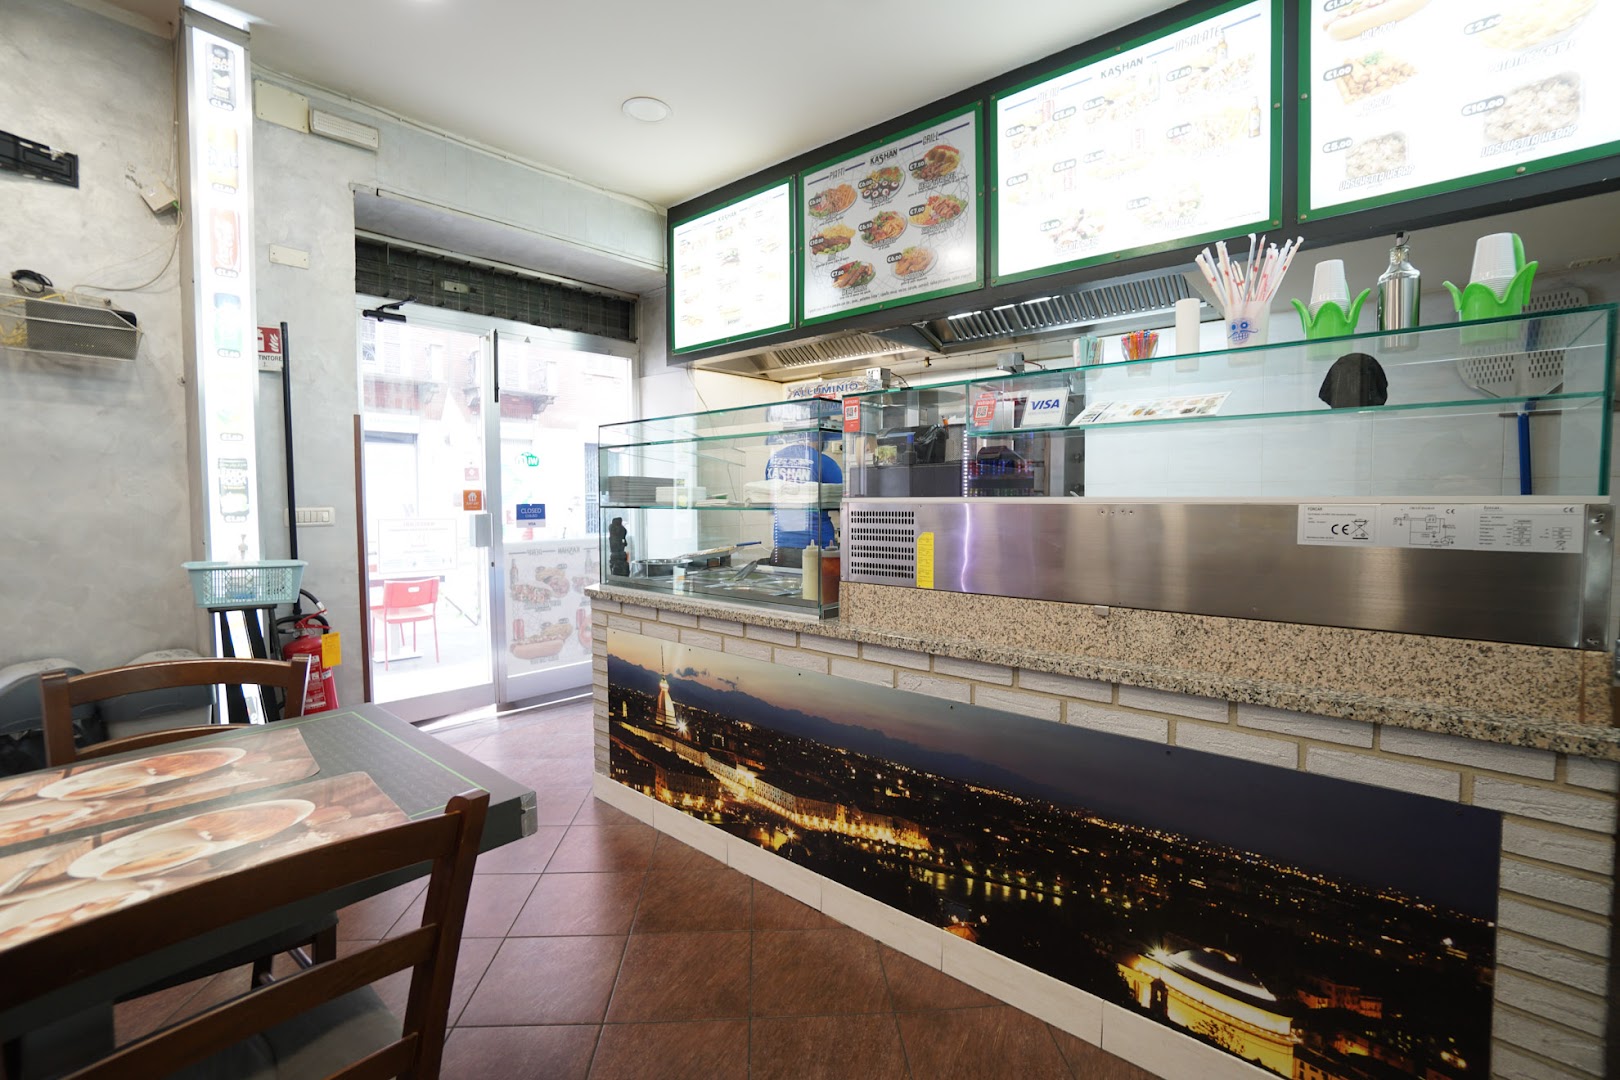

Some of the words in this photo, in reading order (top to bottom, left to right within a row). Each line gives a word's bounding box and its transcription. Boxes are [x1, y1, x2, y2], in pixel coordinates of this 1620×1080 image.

[1465, 14, 1503, 34] €2.00
[1174, 26, 1222, 52] INSALATE
[1100, 57, 1144, 79] KASHAN
[1324, 64, 1353, 81] €1.00
[1461, 95, 1505, 116] €10.00
[922, 133, 940, 146] GRILL
[1323, 137, 1353, 153] €5.00
[869, 149, 898, 165] KASHAN
[793, 382, 858, 398] ALLUMINIO
[1031, 399, 1060, 410] VISA
[767, 467, 811, 482] KASHAN
[1331, 524, 1350, 535] CE
